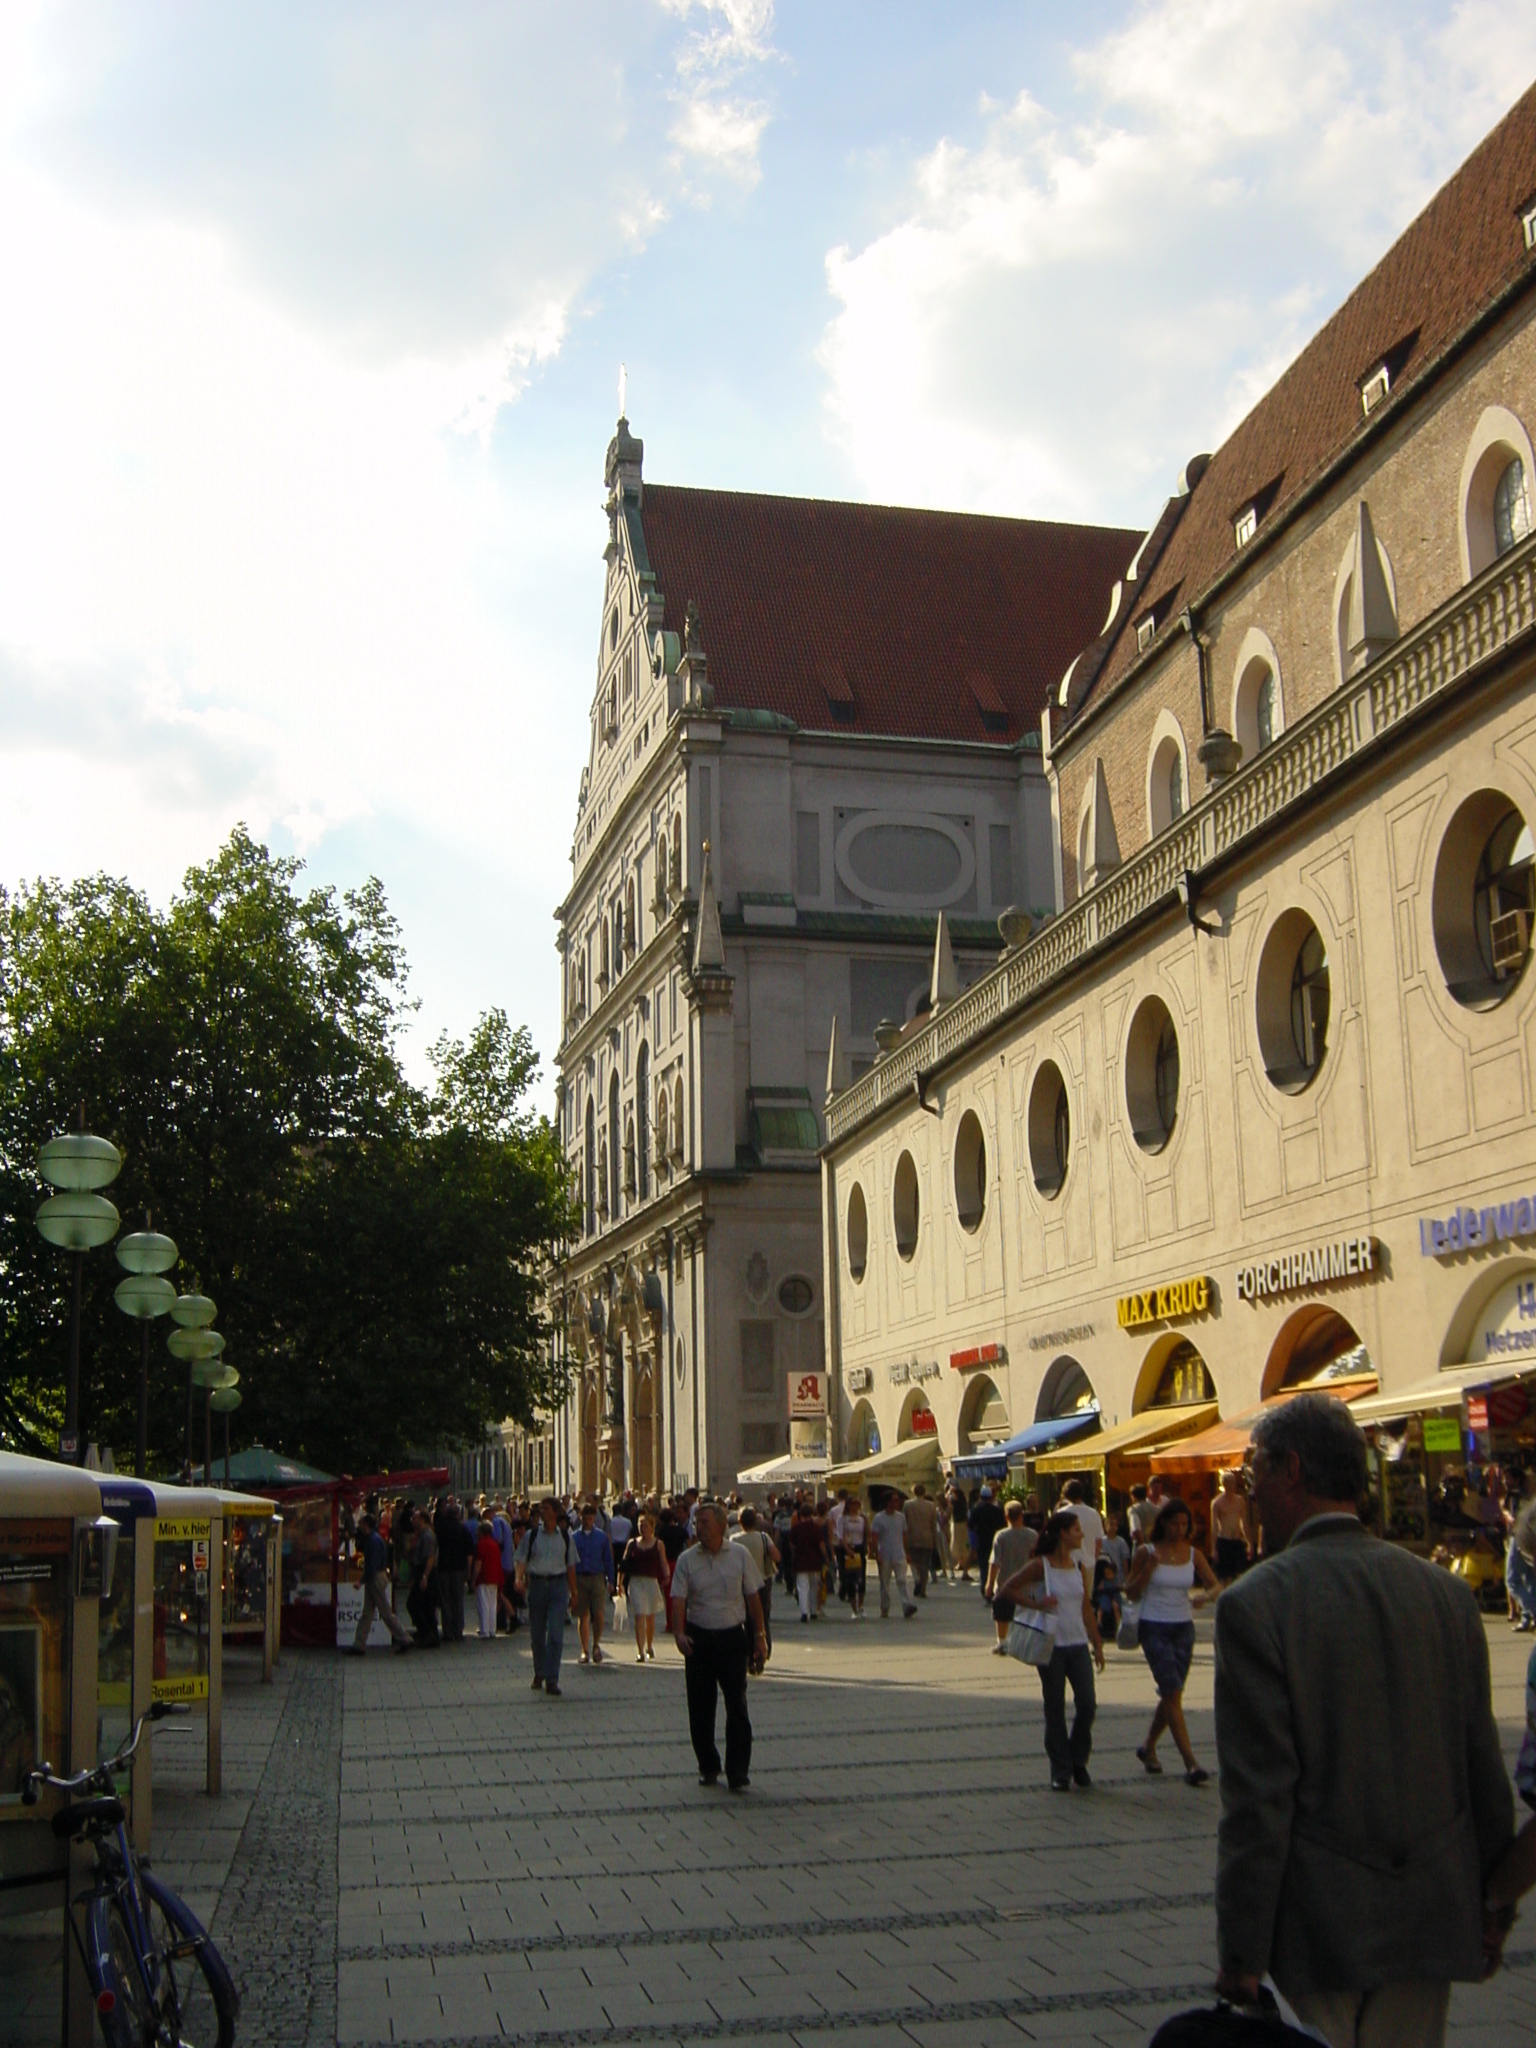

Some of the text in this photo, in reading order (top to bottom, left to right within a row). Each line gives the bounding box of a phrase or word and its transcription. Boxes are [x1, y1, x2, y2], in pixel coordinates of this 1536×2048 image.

[1236, 1236, 1374, 1300] FORCHHAMMER
[1116, 1275, 1209, 1328] MAX KRUG
[159, 1522, 180, 1536] Min.
[152, 1681, 204, 1698] Rosental 1
